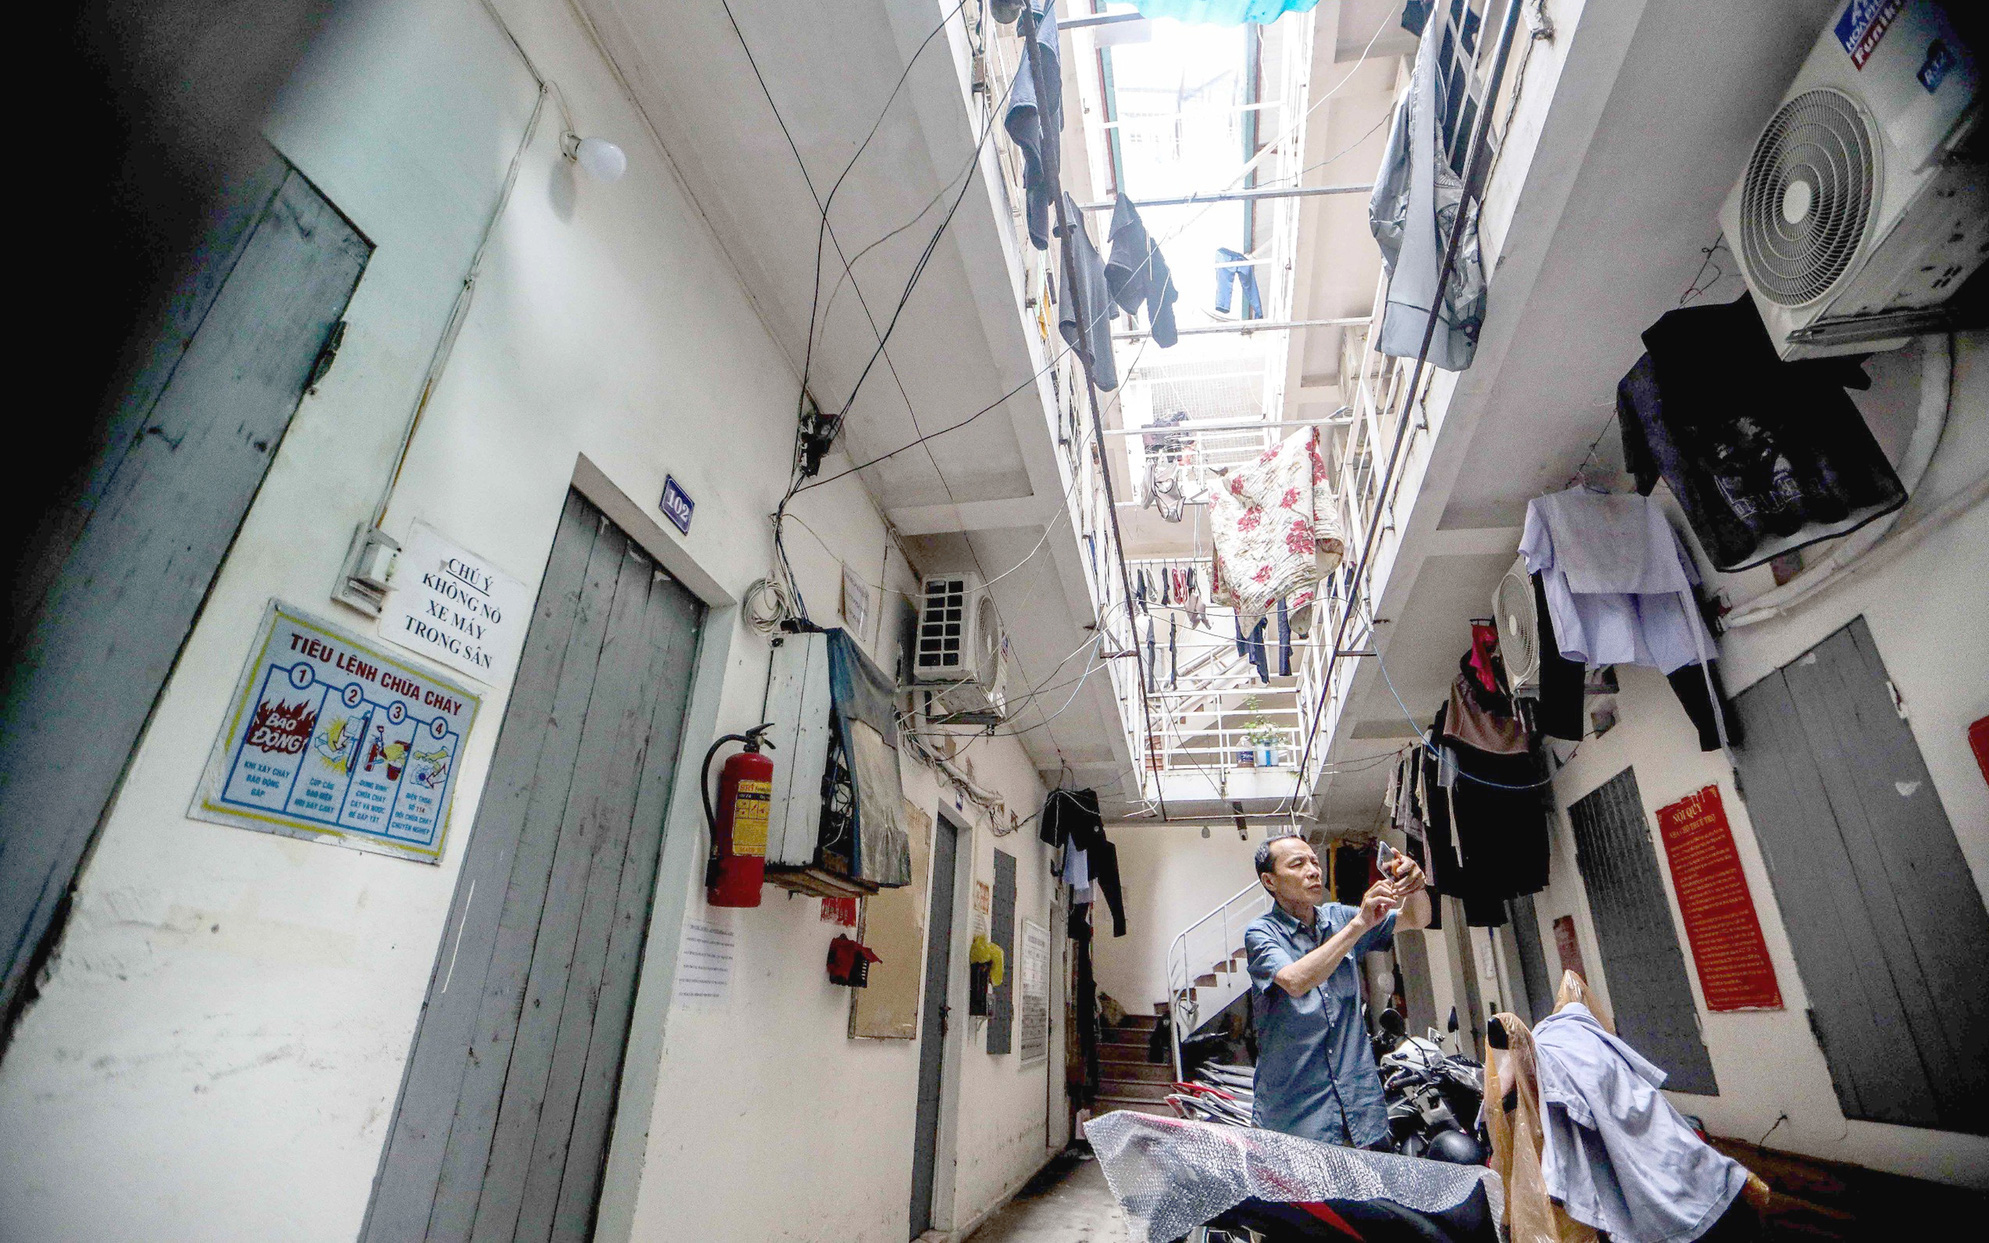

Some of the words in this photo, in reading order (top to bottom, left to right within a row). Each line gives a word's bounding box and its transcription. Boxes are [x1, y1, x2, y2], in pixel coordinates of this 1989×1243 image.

[667, 489, 690, 522] 102
[448, 558, 480, 584] CHÚ
[484, 576, 493, 591] Ý
[422, 573, 479, 612] KHÔNG
[426, 599, 448, 622] XE
[451, 612, 486, 640] MÁY
[404, 614, 462, 654] TRONG
[463, 646, 492, 670] SÂN
[290, 633, 334, 663] TIÊU
[336, 653, 378, 682] LỆNH
[424, 690, 462, 717] CHÁY
[299, 669, 306, 683] 1
[349, 689, 358, 703] 2
[266, 712, 297, 731] BÁO
[393, 707, 402, 719] 3
[251, 726, 302, 752] ĐỘNG
[434, 723, 444, 738] 4
